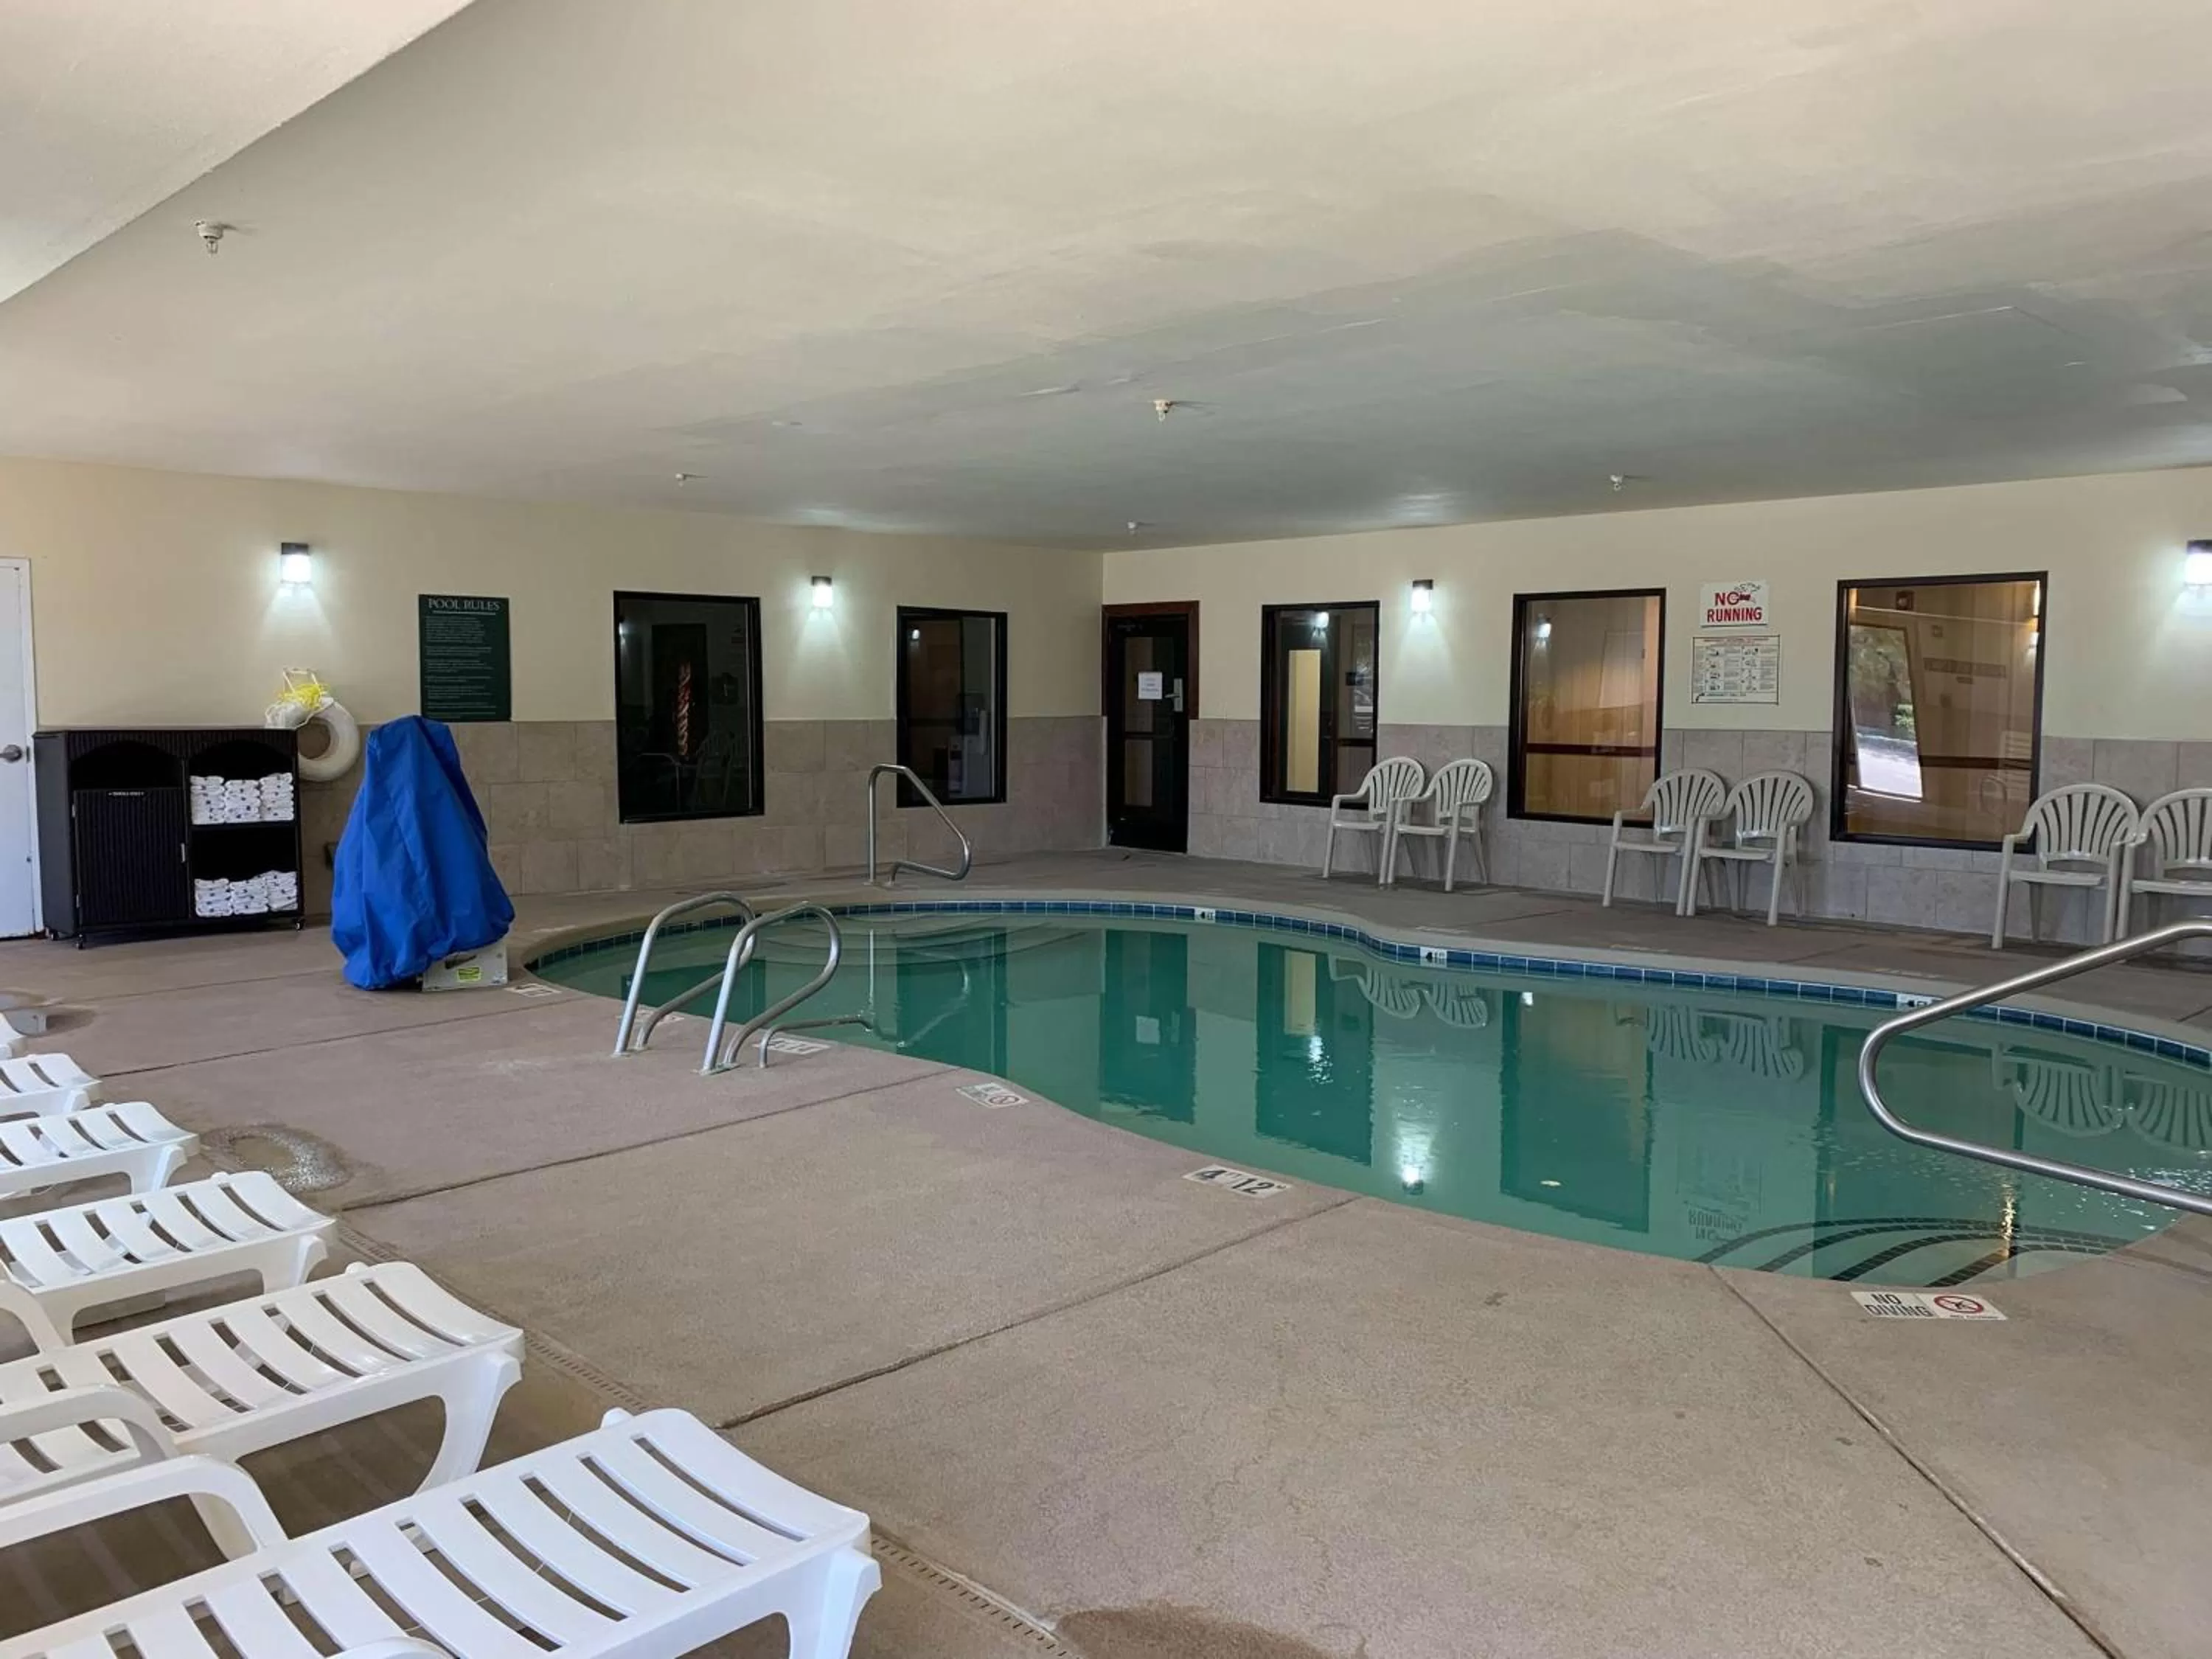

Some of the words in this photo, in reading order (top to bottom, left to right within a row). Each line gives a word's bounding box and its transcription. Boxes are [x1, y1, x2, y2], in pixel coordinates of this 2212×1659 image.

[428, 598, 460, 609] POOL
[463, 599, 500, 611] RULES
[1715, 591, 1740, 605] NO
[1707, 607, 1763, 622] RUNNING
[1194, 1169, 1227, 1180] 4
[1871, 1293, 1902, 1305] NO
[1864, 1304, 1935, 1317] DIVING
